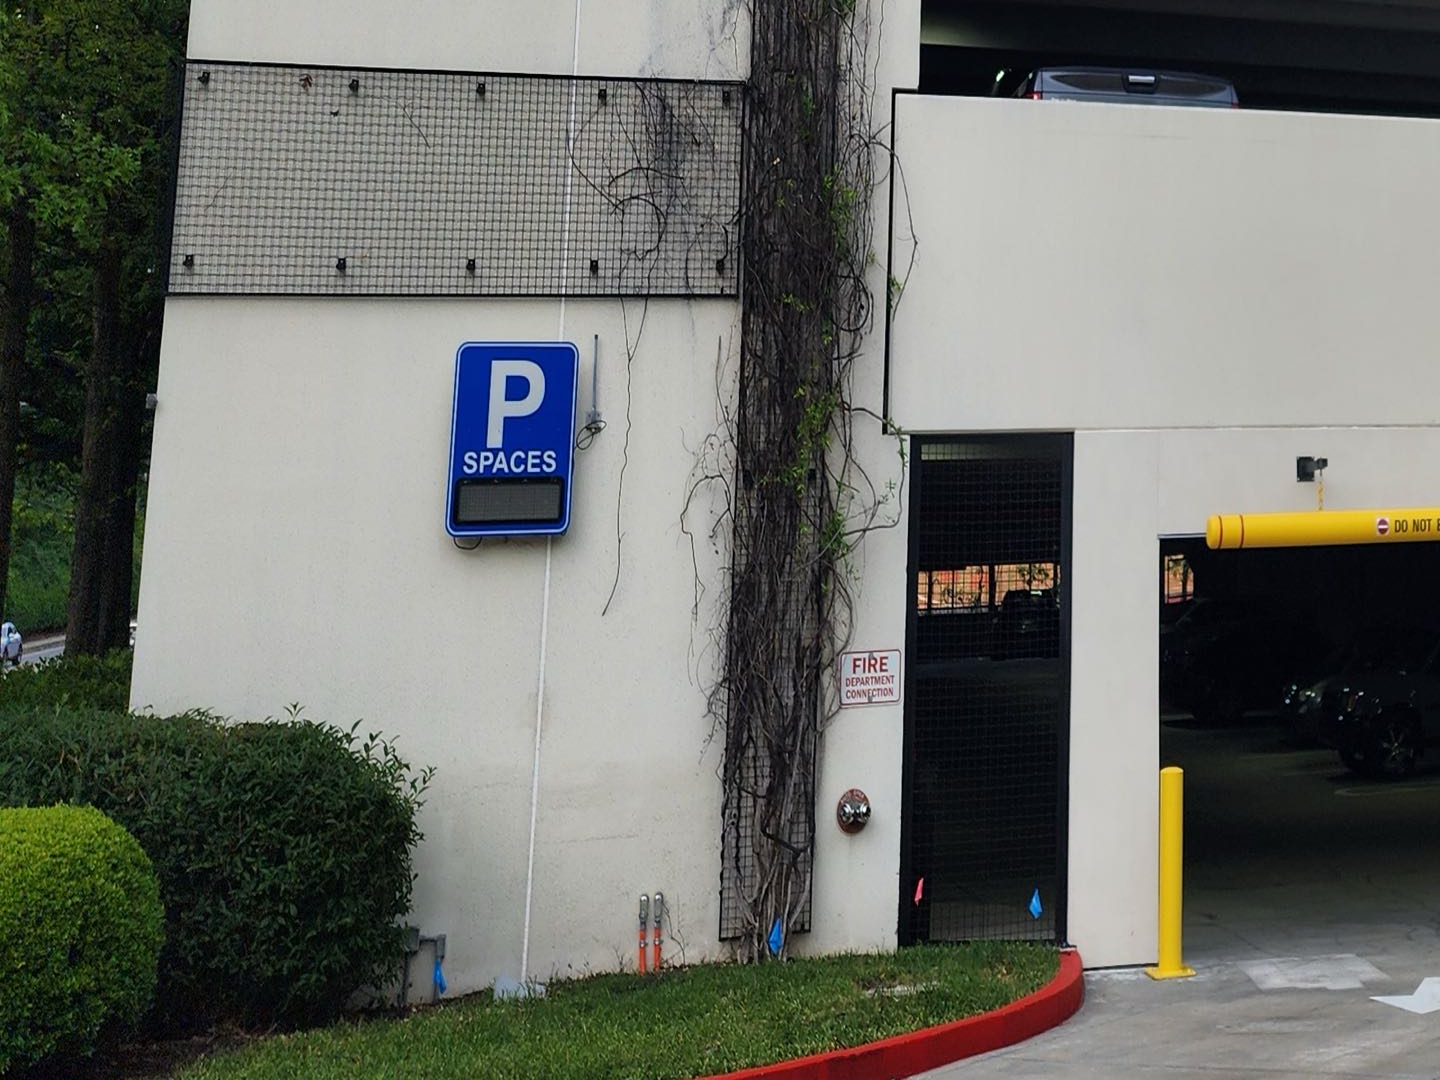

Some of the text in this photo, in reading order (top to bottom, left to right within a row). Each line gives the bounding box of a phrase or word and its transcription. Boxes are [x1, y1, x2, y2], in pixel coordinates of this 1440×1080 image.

[486, 360, 546, 448] P
[463, 451, 557, 474] SPACES
[1394, 520, 1408, 533] DO
[1412, 519, 1432, 532] NOT
[852, 656, 889, 674] FIRE
[845, 675, 895, 688] DEPARTMENT
[845, 687, 894, 700] CONNECTION
